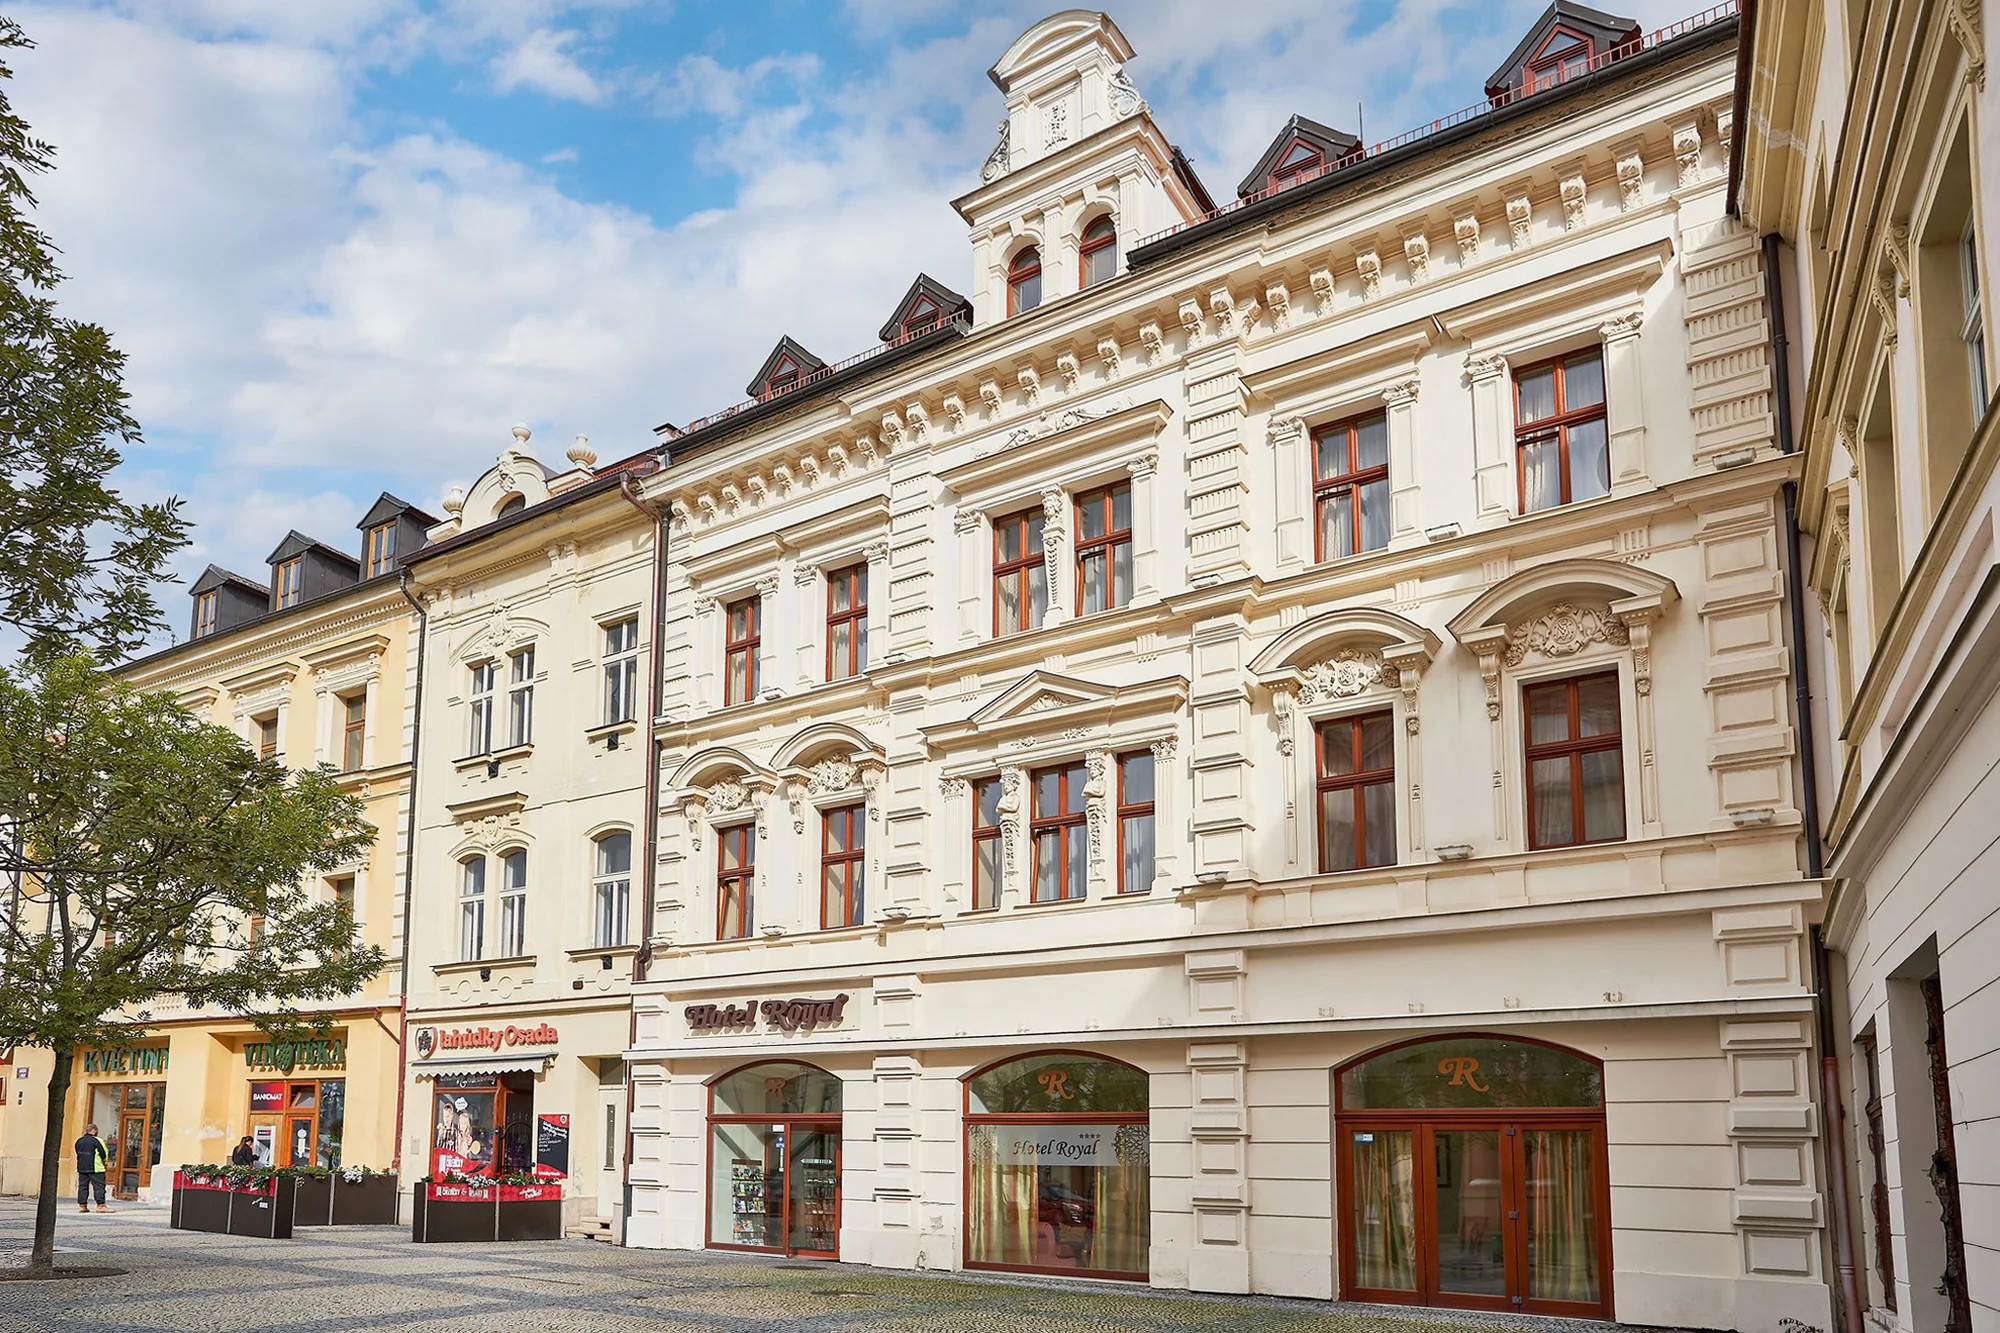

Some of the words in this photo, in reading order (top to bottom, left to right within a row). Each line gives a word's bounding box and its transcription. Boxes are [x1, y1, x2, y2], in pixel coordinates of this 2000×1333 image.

[684, 1000, 759, 1030] Hotel
[760, 993, 850, 1032] Royal
[504, 1023, 558, 1047] Osada
[1037, 1069, 1075, 1099] R
[1438, 1057, 1490, 1092] R
[253, 1093, 283, 1101] BANKOMAT
[1013, 1139, 1055, 1155] Hotel
[1056, 1139, 1100, 1160] Royal
